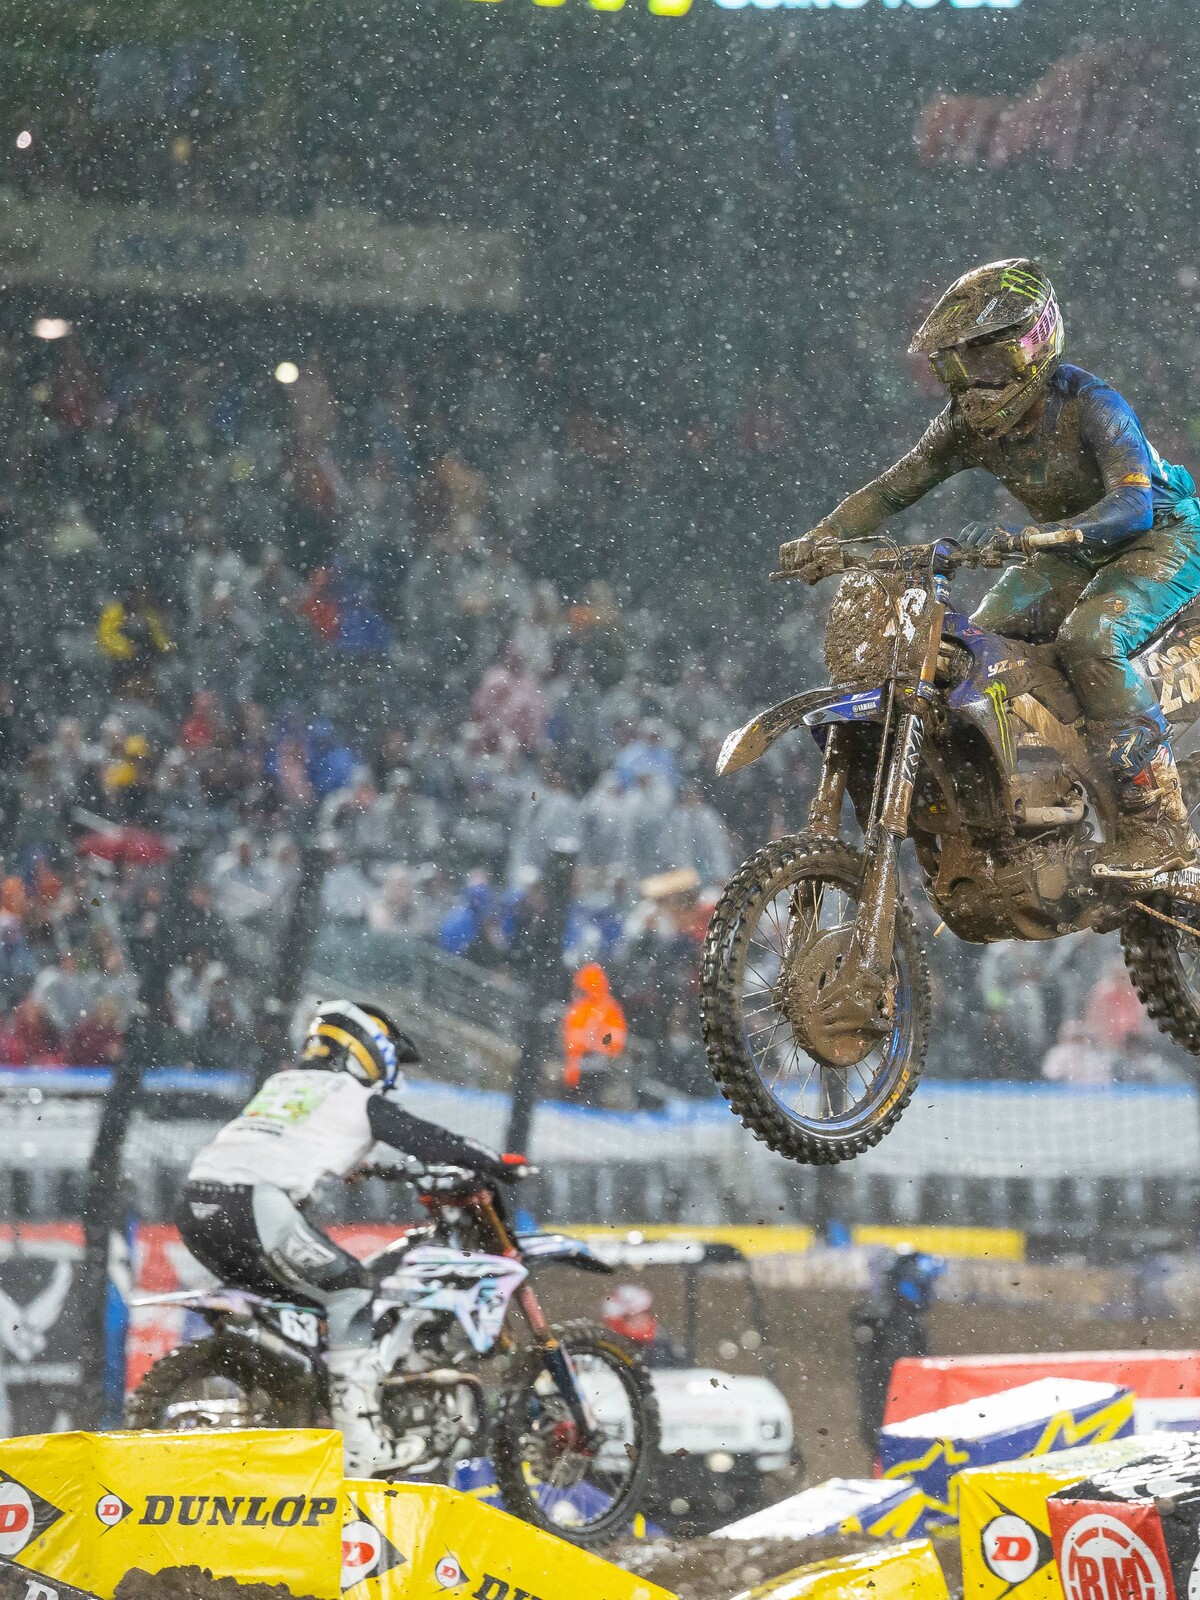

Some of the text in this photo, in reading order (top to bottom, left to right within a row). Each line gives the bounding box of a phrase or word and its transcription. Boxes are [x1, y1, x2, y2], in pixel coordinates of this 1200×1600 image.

[279, 1309, 319, 1347] 63
[138, 1495, 337, 1527] DUNLOP
[991, 1536, 1032, 1562] D
